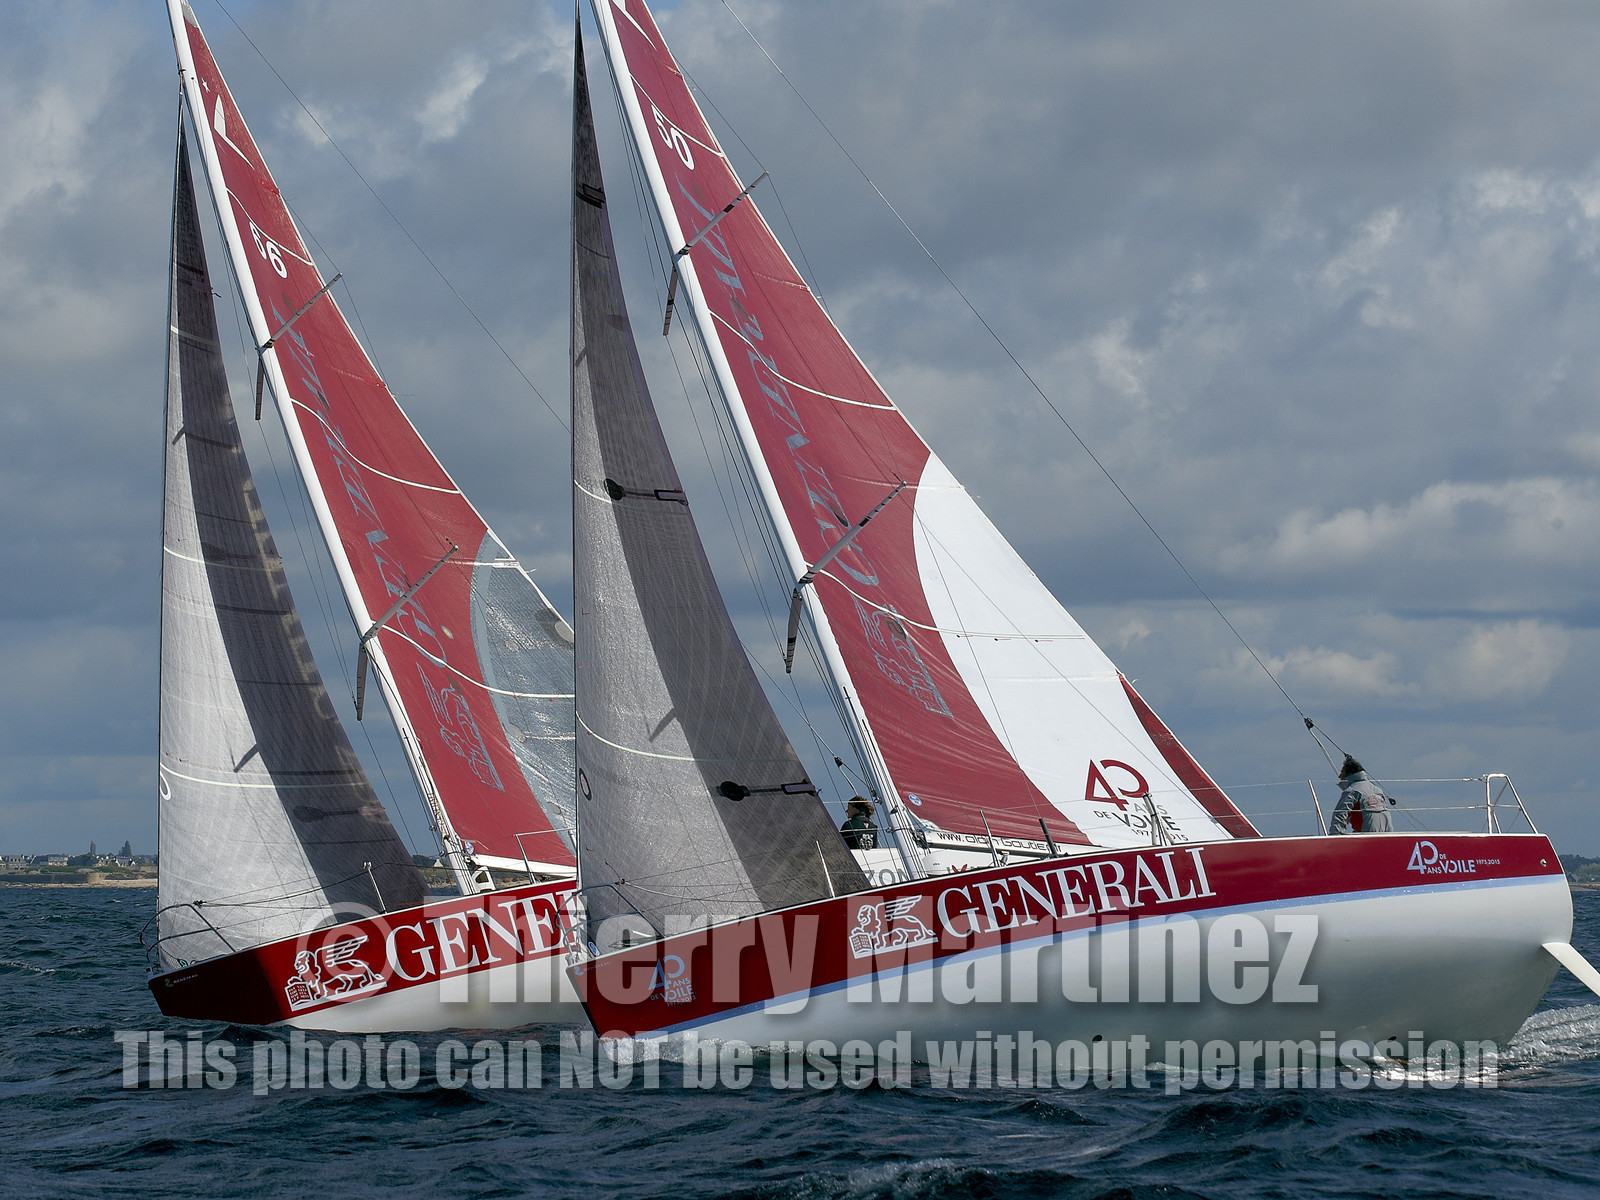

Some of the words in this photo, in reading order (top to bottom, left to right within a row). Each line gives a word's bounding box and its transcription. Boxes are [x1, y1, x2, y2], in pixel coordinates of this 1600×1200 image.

[650, 104, 695, 171] 50
[1093, 810, 1112, 819] DE
[1134, 802, 1168, 815] AS
[1406, 840, 1439, 875] 40
[1427, 866, 1442, 875] ANS
[1438, 859, 1476, 874] VOILE
[936, 846, 1217, 939] GENERALI
[647, 954, 686, 991] 40
[672, 977, 691, 988] ANS
[660, 985, 695, 1002] VOILE
